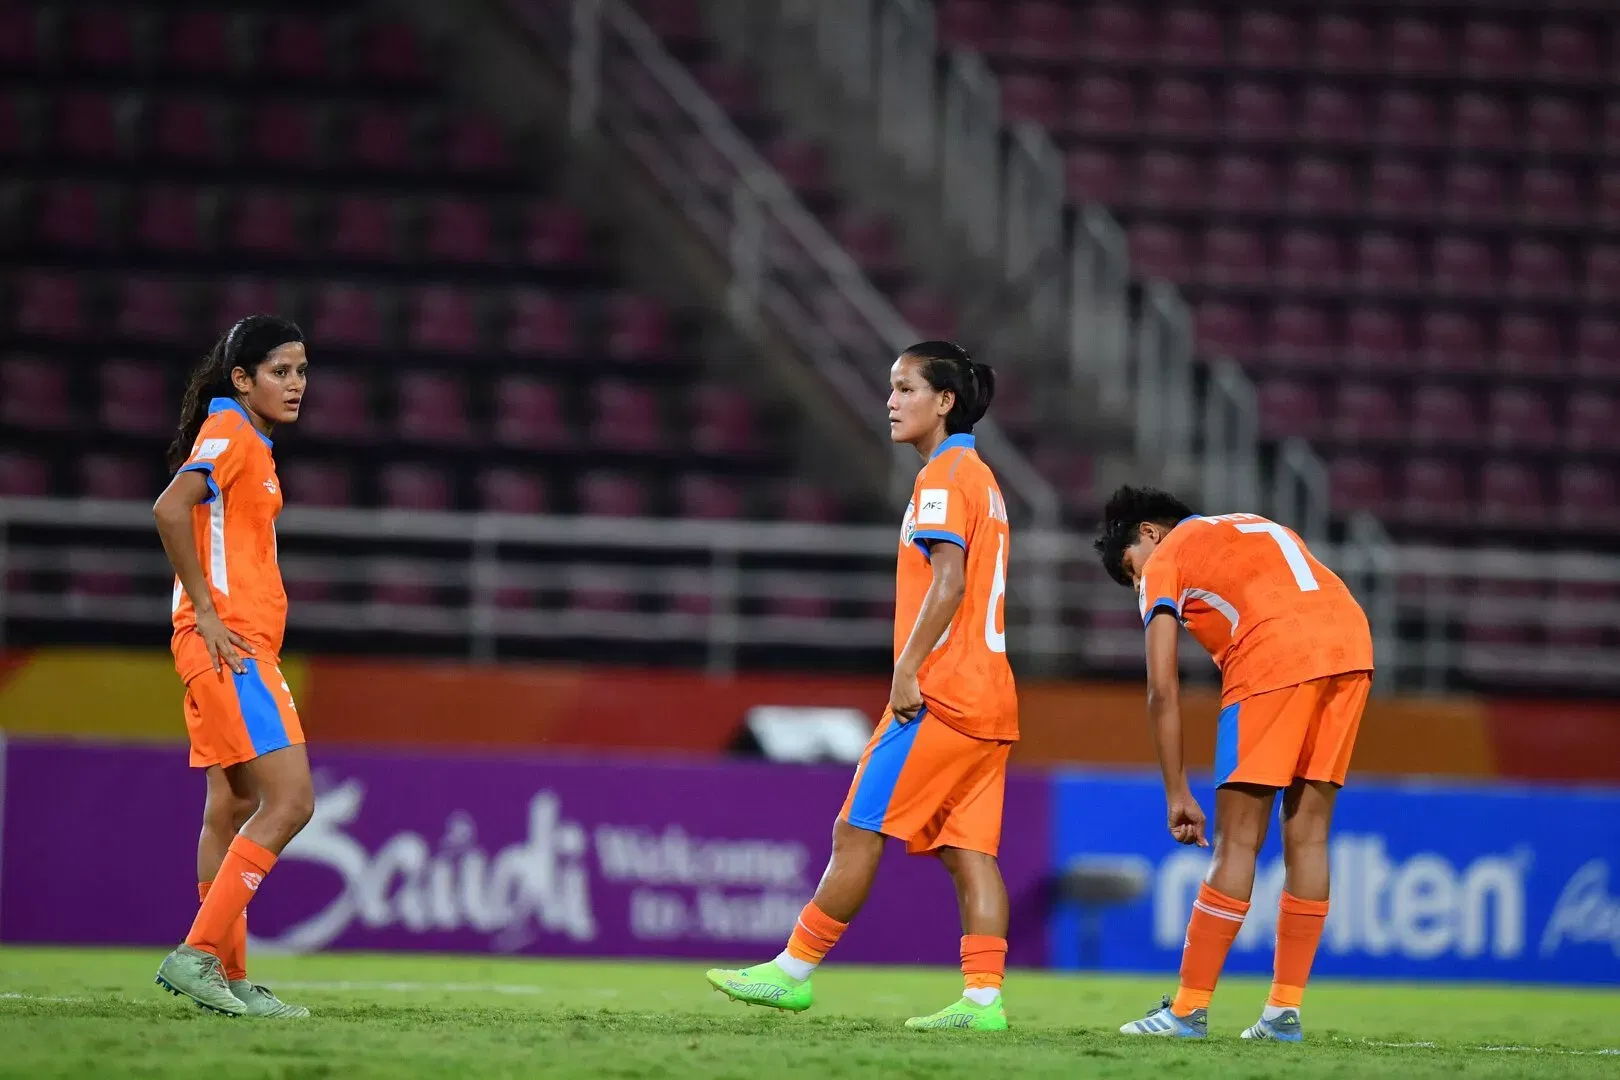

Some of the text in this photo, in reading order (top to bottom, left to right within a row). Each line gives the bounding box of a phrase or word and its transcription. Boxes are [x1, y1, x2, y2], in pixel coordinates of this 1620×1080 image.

[922, 501, 943, 510] AFC
[1232, 522, 1320, 592] 7
[247, 778, 594, 954] Saudi
[1153, 835, 1527, 958] mlten
[725, 979, 788, 1001] PREDATOR
